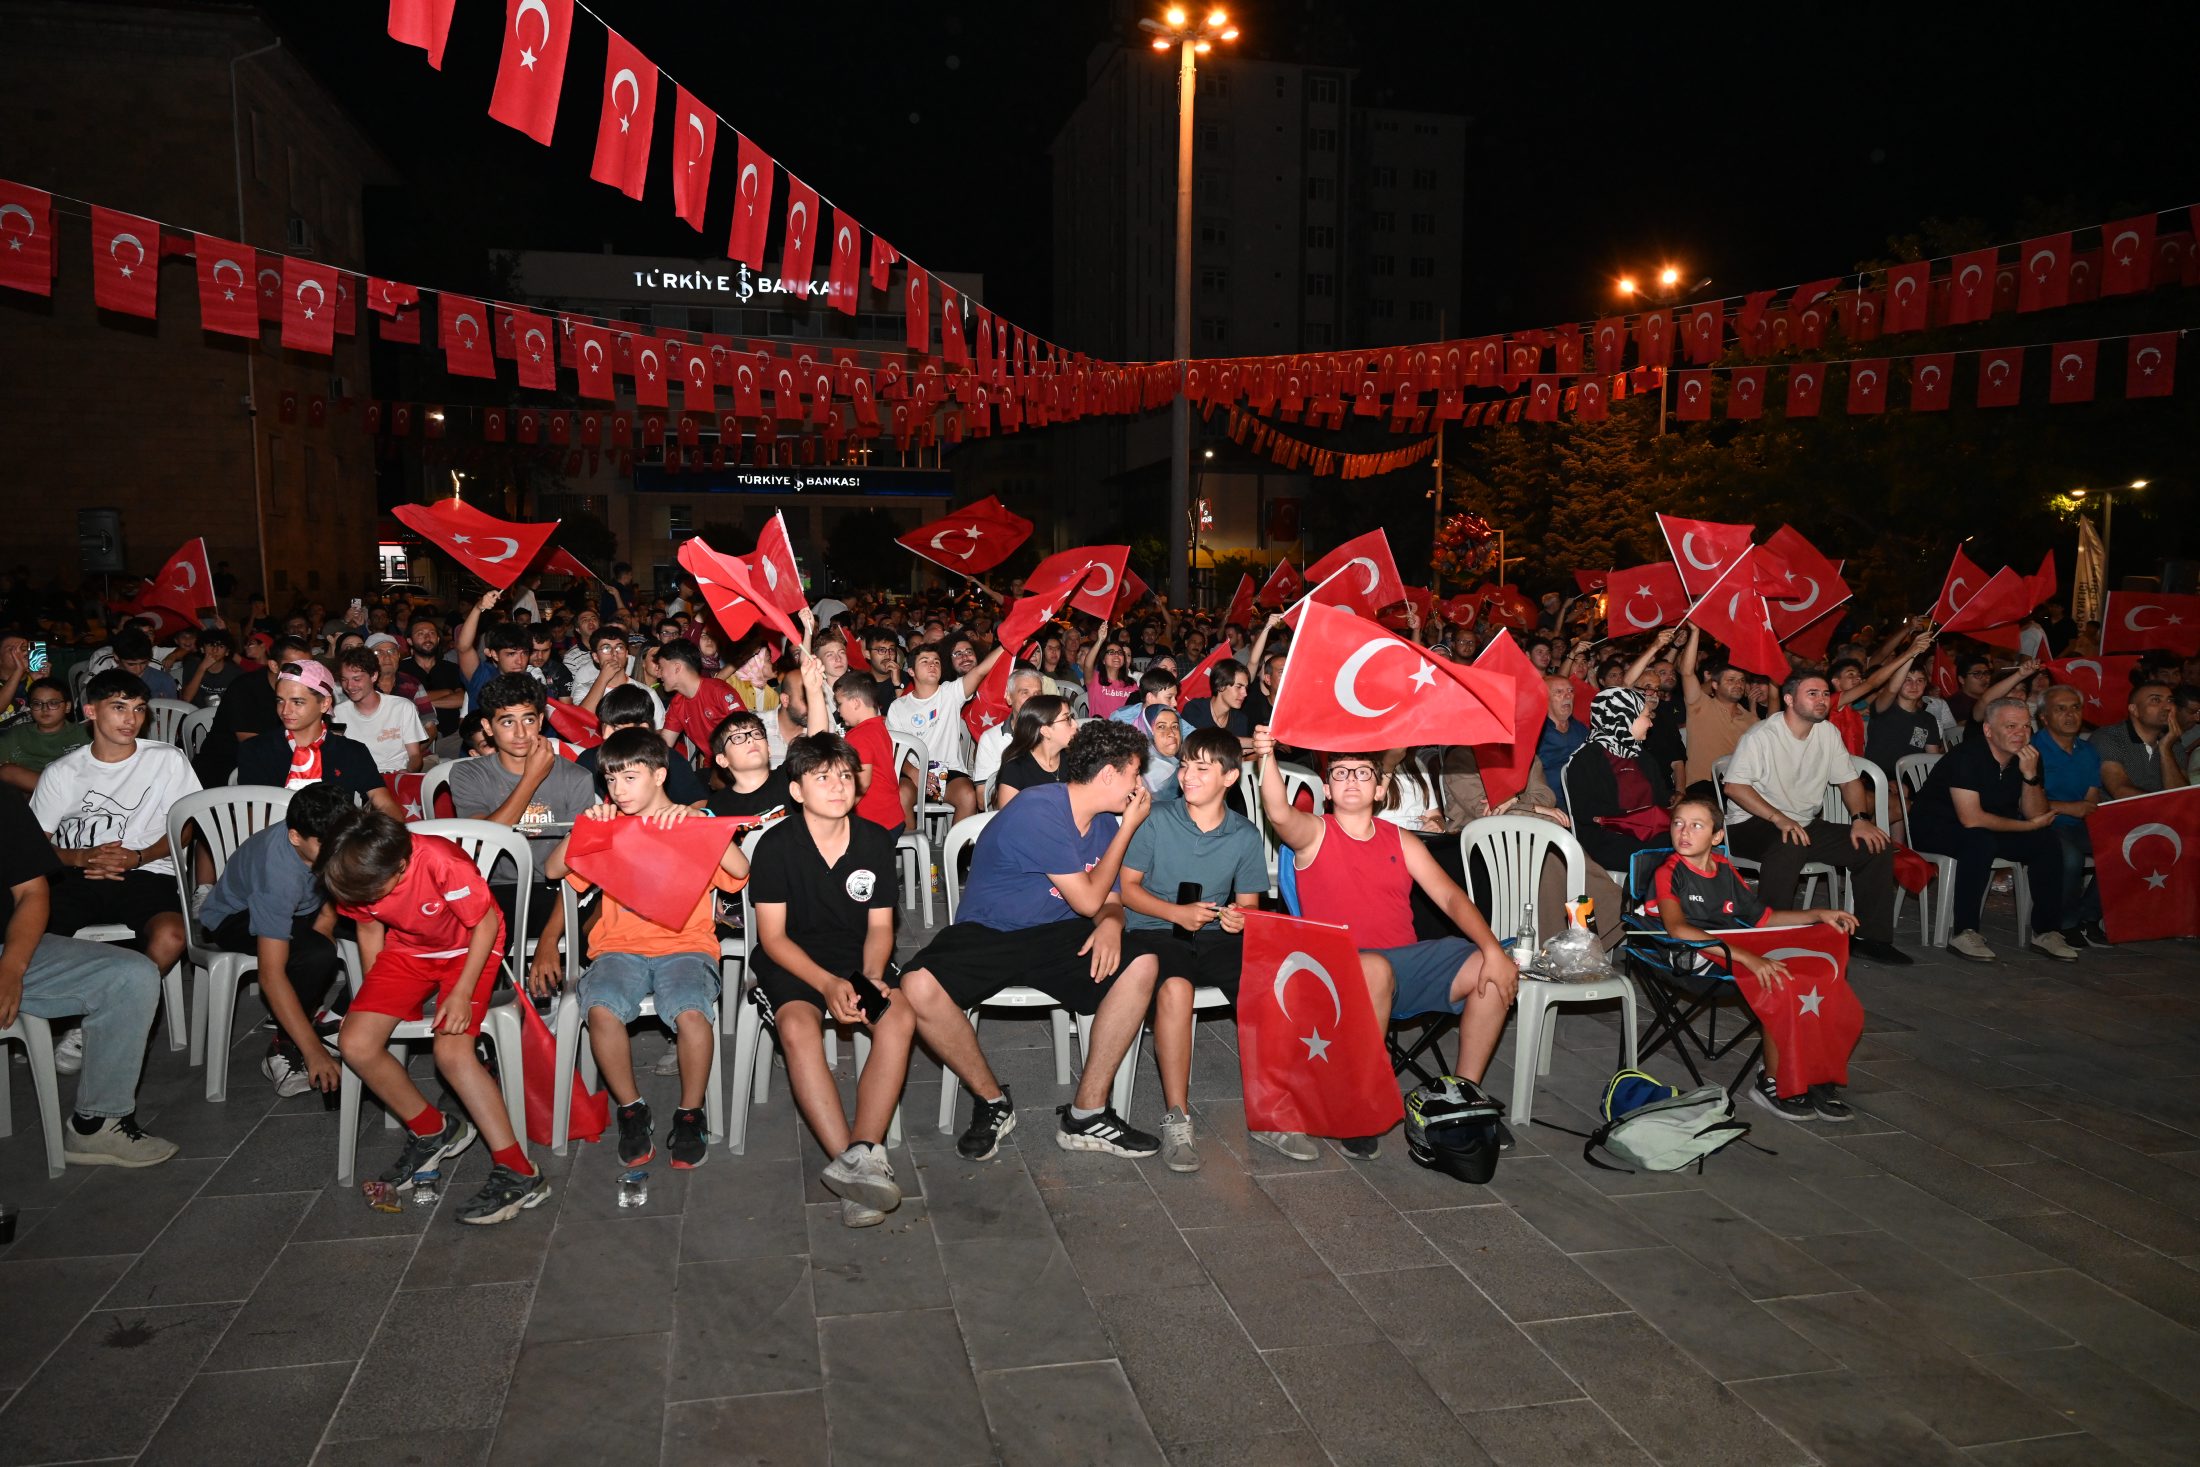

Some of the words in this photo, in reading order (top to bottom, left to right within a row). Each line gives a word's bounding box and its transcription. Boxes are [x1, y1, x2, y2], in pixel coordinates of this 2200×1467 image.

[633, 268, 730, 291] TÜRKİYE
[737, 474, 791, 486] TÜRKİYE
[806, 477, 860, 487] BANKASI
